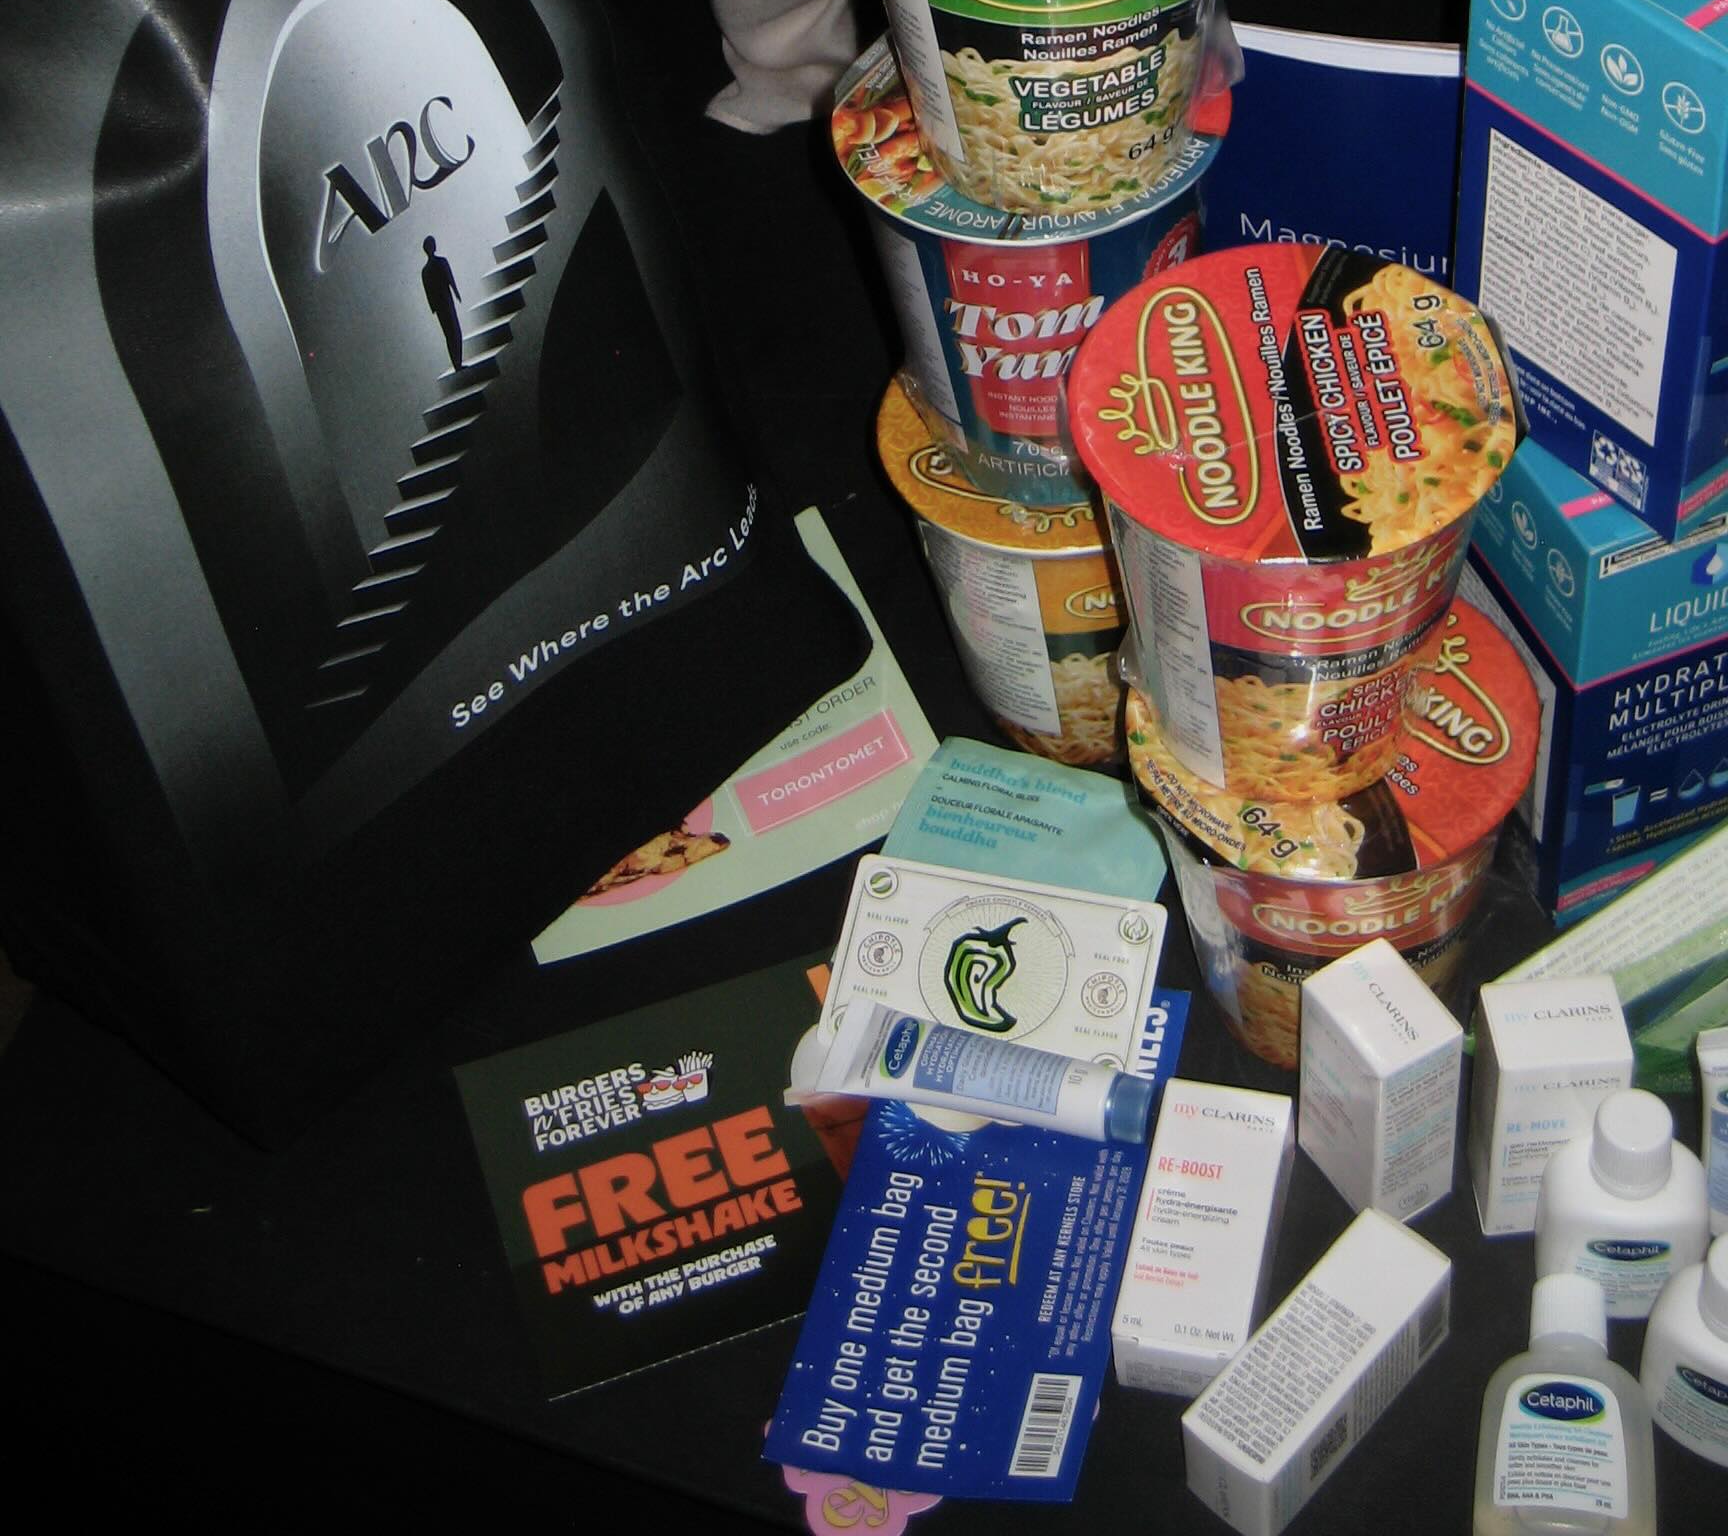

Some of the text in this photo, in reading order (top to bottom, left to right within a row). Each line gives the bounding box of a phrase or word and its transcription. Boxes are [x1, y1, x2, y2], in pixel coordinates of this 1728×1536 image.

[1021, 6, 1162, 46] Ramen Noodles
[1023, 23, 1159, 62] Nouilles Ramen
[1014, 47, 1165, 98] VEGETABLE
[1024, 88, 1156, 131] LÉGUMES
[1032, 98, 1082, 109] FLAVOUR
[1128, 125, 1175, 159] 64 g
[316, 96, 475, 273] ARC
[925, 198, 1006, 230] ARÔME
[962, 269, 1073, 287] HO-YA
[944, 296, 1105, 342] Tom
[1164, 301, 1209, 376] KING
[1412, 295, 1446, 348] 64 g
[1246, 267, 1323, 531] Ramen Noodles Nouilles Ramen
[1300, 314, 1363, 471] SPICY CHICKEN
[1339, 333, 1380, 447] FLAVOUR SAVEUR DE
[1353, 313, 1420, 460] POULET ÉPICÉ
[1179, 382, 1239, 508] NOODLE
[1262, 581, 1420, 630] NOODLE
[452, 680, 504, 728] See
[508, 612, 610, 681] Where
[618, 583, 671, 617] the
[680, 547, 728, 590] Arc
[816, 676, 877, 714] ORDER
[1353, 667, 1401, 697] SPICY
[1609, 675, 1728, 731] MULTIPL
[1615, 652, 1728, 708] HYDRAT
[780, 738, 799, 751] use
[757, 736, 885, 806] TORONTOMET
[942, 773, 981, 789] CALMING
[981, 782, 1014, 799] FLORAL
[1036, 777, 1088, 805] blend
[931, 794, 1064, 837] DOUCEUR FLORALE APAISANTE
[1242, 807, 1298, 858] 64 g
[1271, 904, 1422, 937] NOODLE
[1368, 981, 1419, 1041] CLARINS
[1533, 1004, 1612, 1021] CLARINS
[524, 1063, 647, 1117] BURGERS
[1173, 1102, 1276, 1127] my CLARINS
[535, 1103, 643, 1152] FOREVER
[522, 1105, 792, 1258] FREE
[1158, 1155, 1224, 1180] RE-BOOST
[870, 1171, 923, 1219] bag
[542, 1177, 803, 1296] MILKSHAKE
[1038, 1175, 1086, 1323] REDEEM AT ANY KERNELS STORE
[1593, 1242, 1660, 1257] Cetaphil
[593, 1234, 778, 1308] WITH THE PURCHASE
[619, 1257, 763, 1315] OF ANY BURGER
[846, 1227, 901, 1333] medium
[866, 1204, 958, 1463] and get the second
[940, 1298, 994, 1347] bag
[830, 1341, 868, 1391] one
[1681, 1367, 1728, 1400] Cetap
[802, 1397, 858, 1452] Buy
[916, 1357, 971, 1468] medium
[1527, 1391, 1598, 1413] Cetaphil
